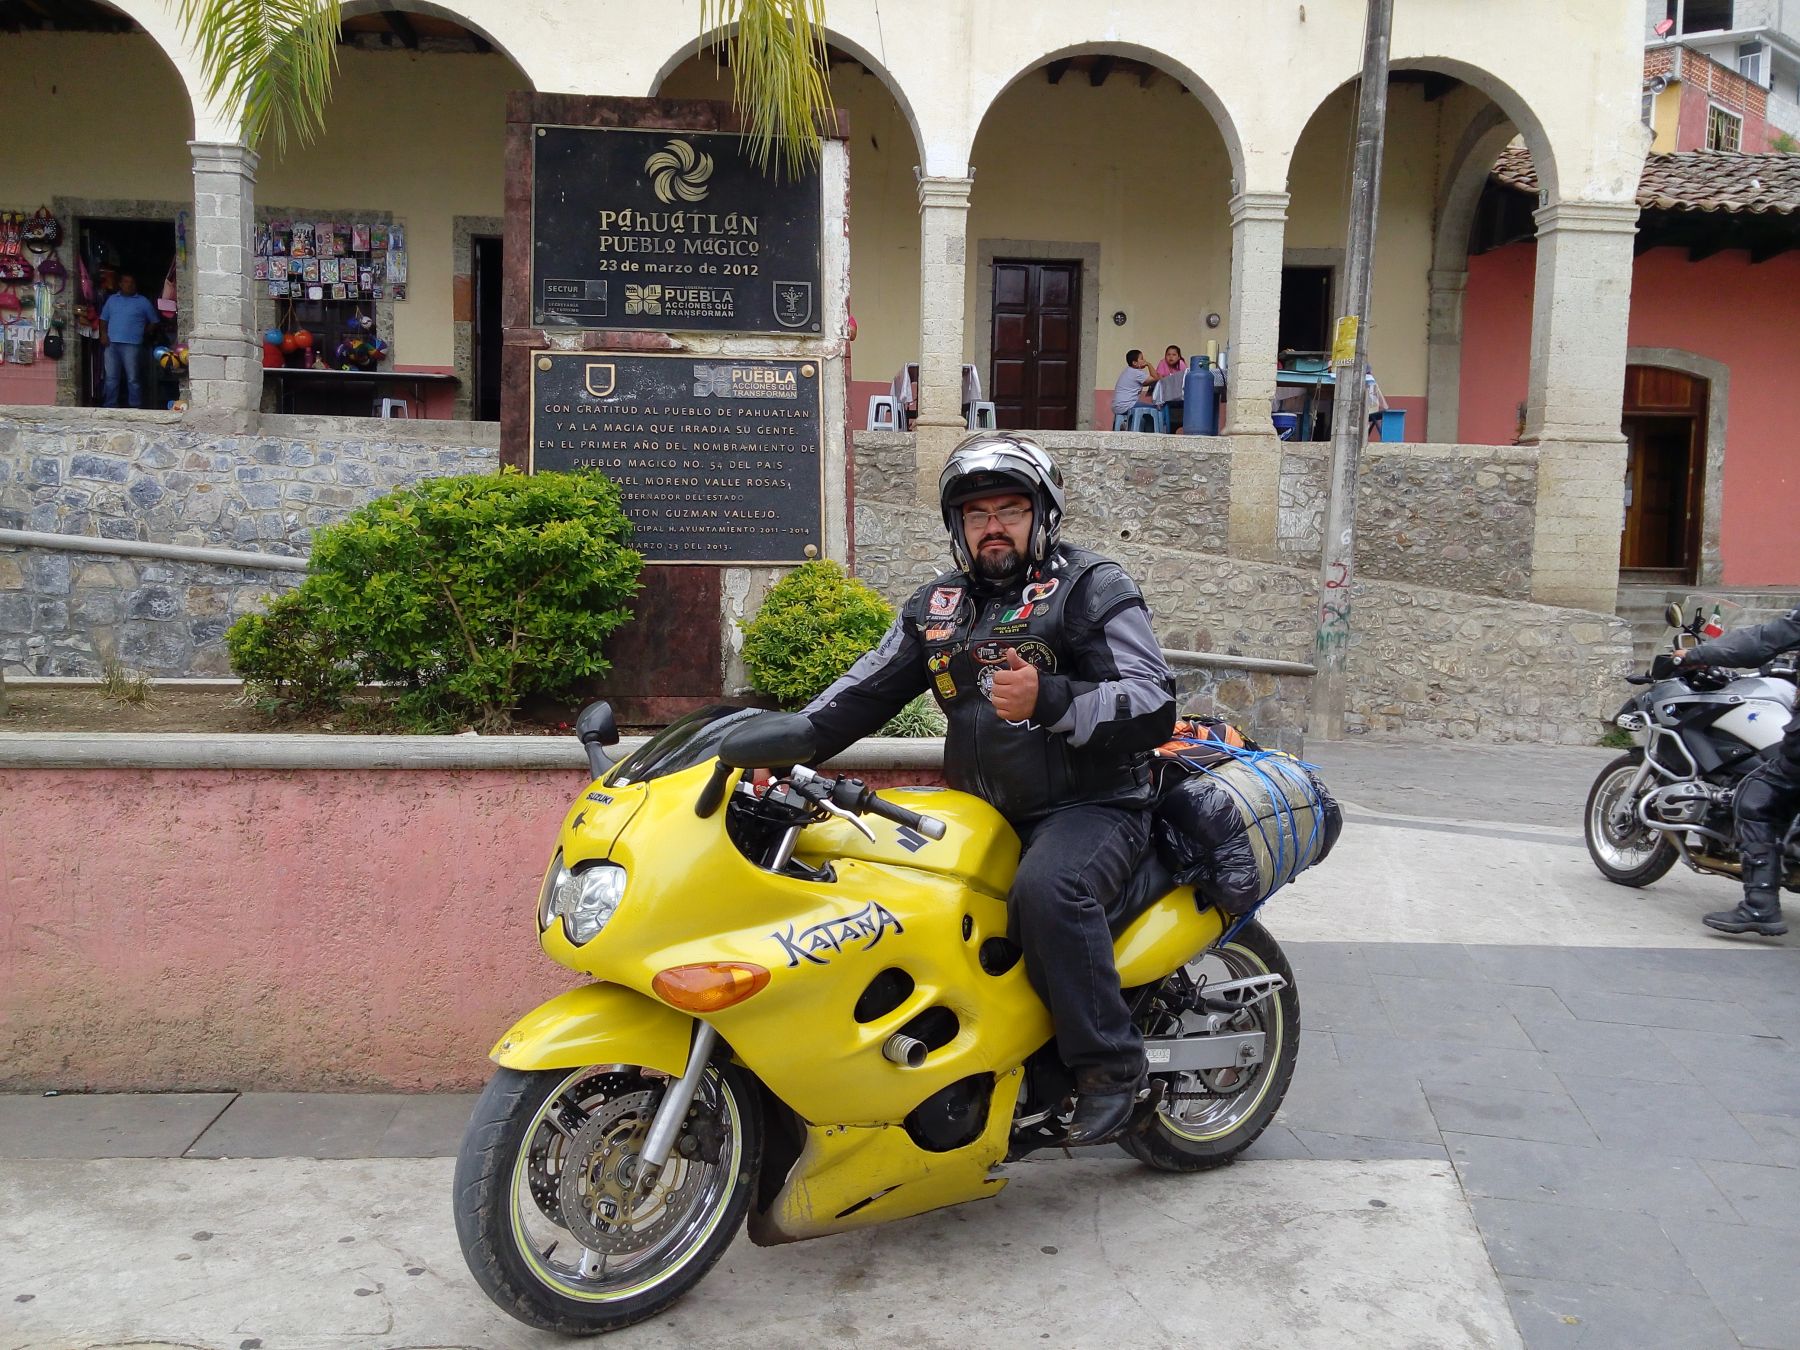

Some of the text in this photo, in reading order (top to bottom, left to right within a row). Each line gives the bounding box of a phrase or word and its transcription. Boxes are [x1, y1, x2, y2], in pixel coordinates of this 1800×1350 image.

[599, 259, 759, 276] 23 de marzo de 2012
[547, 285, 579, 294] SECTUR
[664, 289, 734, 303] PUEBLA
[664, 302, 734, 311] ACCIONES QUE
[664, 309, 734, 318] TRANSFORMAN
[732, 369, 796, 384] PUEBLA
[732, 382, 797, 391] ACCIONES QUE
[732, 389, 797, 398] TRANSFORMAN
[544, 404, 810, 418] CON GRATITUD AL PUEBLO DE PAHUATLAN
[556, 422, 563, 431] Y
[568, 423, 577, 431] A
[582, 423, 598, 432] LA
[603, 424, 644, 432] MAGIA
[650, 424, 675, 434] QUE
[680, 425, 731, 434] IRRADIA
[736, 426, 751, 434] SU
[539, 440, 816, 453] EN EL PRIMER AÑO DEL NOMBRAMIENTO DE
[573, 458, 621, 467] PUEBLO
[628, 459, 677, 468] MAGICO
[710, 461, 722, 470] 54
[729, 461, 751, 469] DEL
[609, 476, 639, 485] FAEL
[645, 477, 699, 486] MORENO
[705, 478, 741, 487] VALLE
[619, 493, 681, 501] OBERNADOR
[622, 508, 660, 517] LITON
[665, 509, 718, 518] GUZMAN
[678, 526, 756, 534] AYUNTAMIENTO
[789, 528, 810, 536] 2014
[628, 542, 663, 550] MARZO
[668, 543, 679, 551] 23
[684, 542, 703, 550] DEL
[1020, 643, 1035, 653] Club
[585, 792, 615, 806] SUZUKI
[769, 901, 904, 968] KATANA
